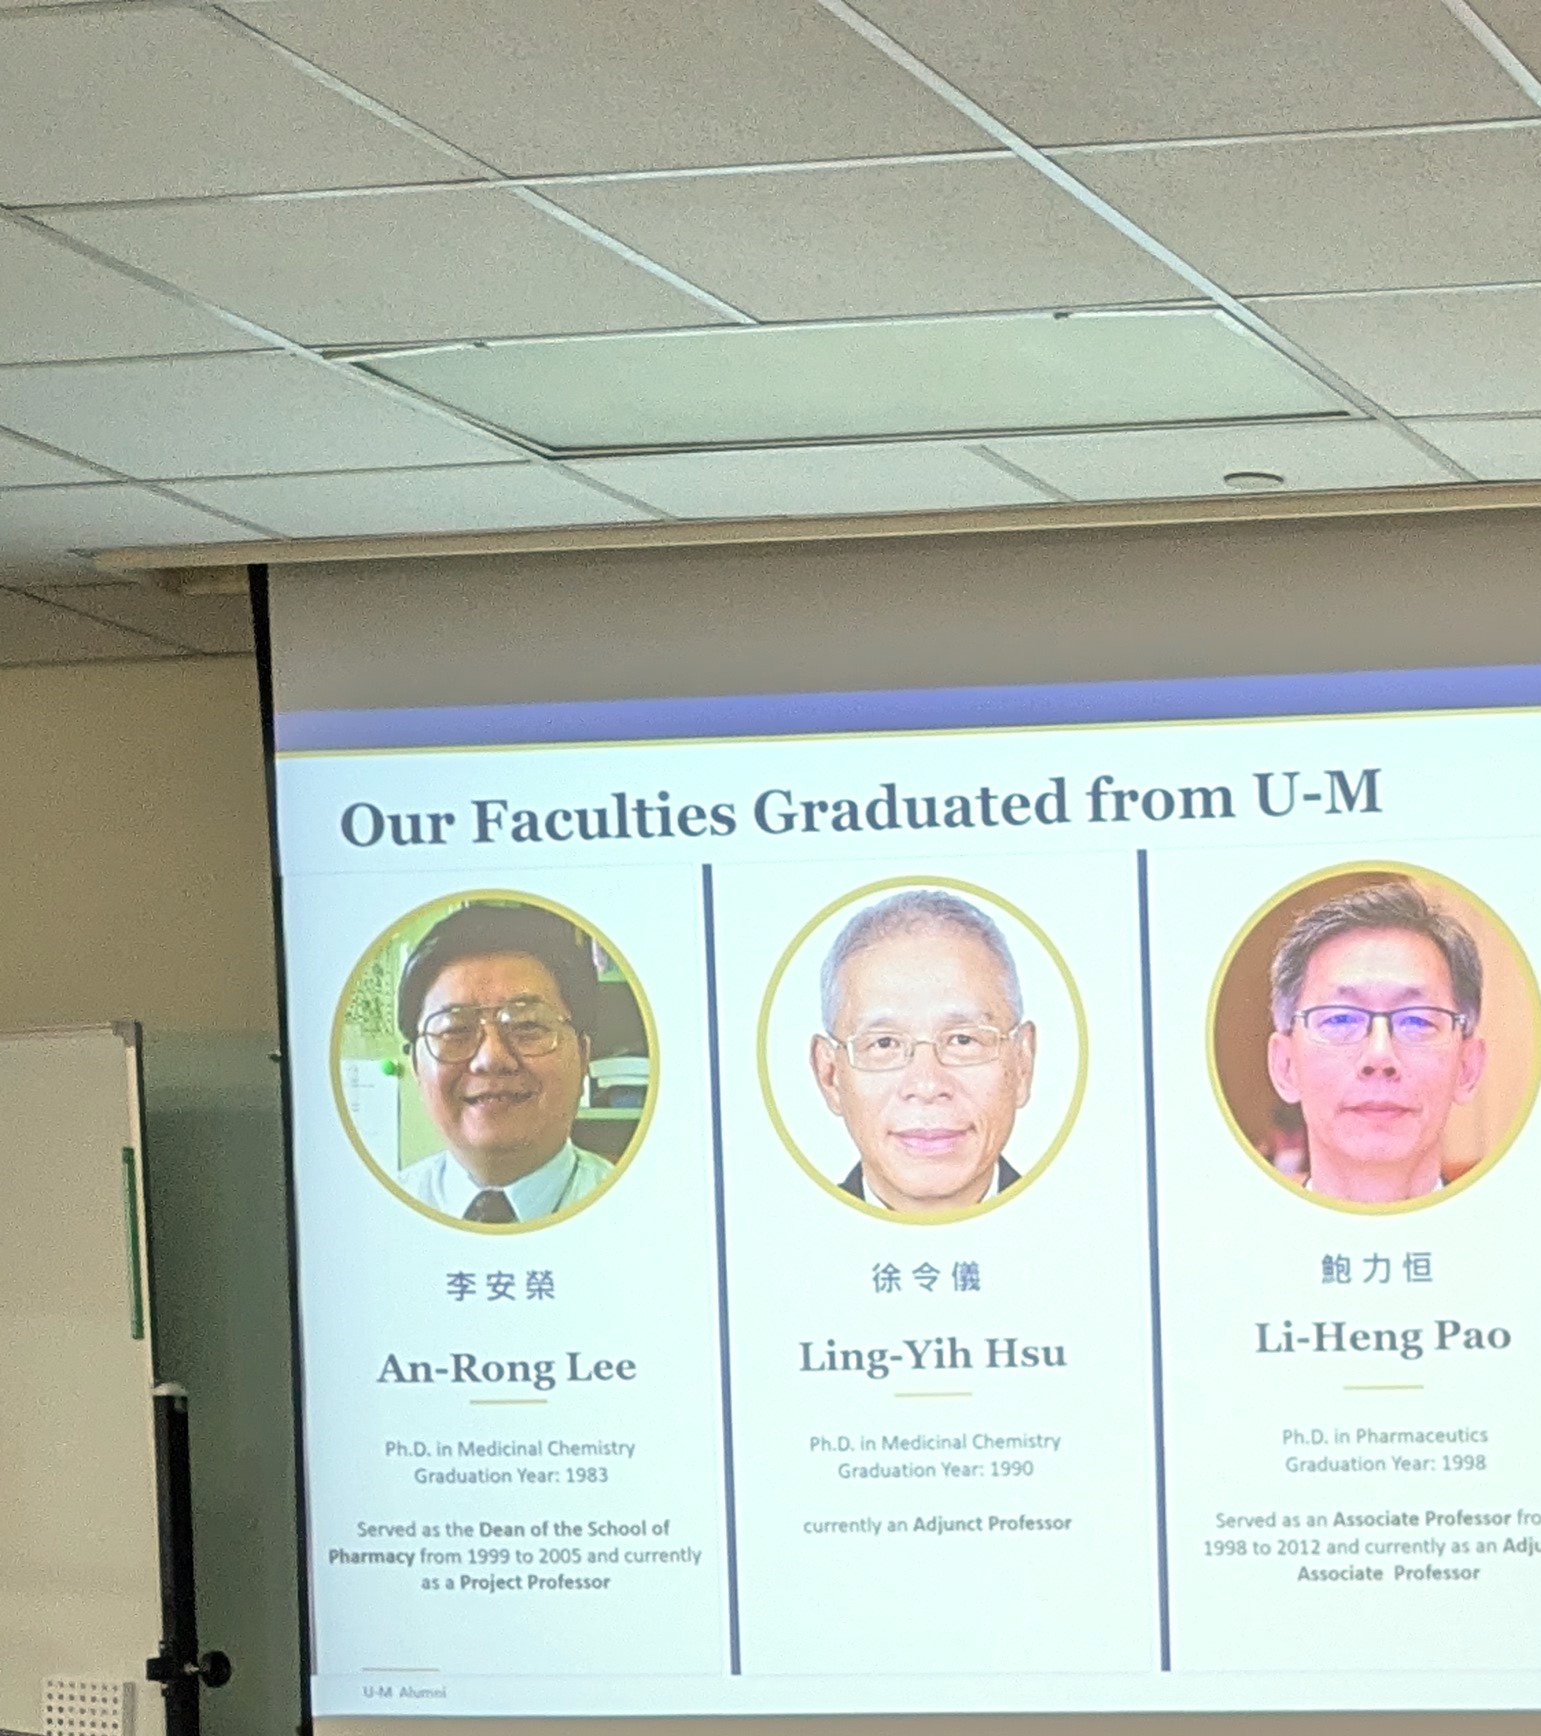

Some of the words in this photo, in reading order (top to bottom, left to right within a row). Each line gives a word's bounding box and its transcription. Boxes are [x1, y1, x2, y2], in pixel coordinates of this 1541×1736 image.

[340, 801, 456, 848] Our
[470, 790, 737, 844] Faculties
[753, 776, 1071, 835] Graduated
[1085, 774, 1237, 823] from
[1252, 767, 1383, 818] U-M
[871, 1260, 981, 1294] 徐令儀
[1321, 1251, 1433, 1285] 鮑力恒
[446, 1269, 555, 1302] 李安榮
[1255, 1319, 1424, 1361] Li-Heng
[1434, 1319, 1512, 1351] Pao
[799, 1336, 973, 1380] Ling-Yih
[985, 1337, 1068, 1368] Hsu
[376, 1352, 556, 1392] An-Rong
[566, 1351, 636, 1382] Lee
[809, 1435, 855, 1452] Ph.D.
[860, 1435, 877, 1451] in
[881, 1433, 967, 1452] Medicinal
[971, 1433, 1062, 1452] Chemistry
[1282, 1428, 1329, 1446] Ph.D.
[1334, 1428, 1351, 1444] in
[1356, 1427, 1489, 1444] Pharmaceutics
[384, 1439, 432, 1458] Ph.D.
[436, 1440, 453, 1457] in
[457, 1440, 543, 1458] Medicinal
[547, 1439, 636, 1459] Chemistry
[837, 1462, 937, 1480] Graduation
[940, 1461, 984, 1478] Year:
[991, 1460, 1035, 1478] 1990
[1285, 1456, 1387, 1473] Graduation
[1391, 1455, 1436, 1472] Year:
[1442, 1454, 1487, 1472] 1998
[413, 1467, 513, 1485] Graduation
[516, 1467, 560, 1484] Year:
[566, 1466, 609, 1484] 1983
[356, 1520, 417, 1538] Served
[421, 1525, 441, 1538] as
[444, 1521, 475, 1538] the
[478, 1521, 526, 1538] Dean
[530, 1520, 549, 1538] of
[553, 1520, 583, 1537] the
[587, 1519, 647, 1537] School
[651, 1518, 670, 1536] of
[803, 1517, 882, 1536] currently
[886, 1520, 908, 1533] an
[912, 1515, 984, 1536] Adjunct
[988, 1514, 1073, 1531] Professor
[1215, 1511, 1277, 1529] Served
[1281, 1515, 1301, 1528] as
[1306, 1515, 1328, 1528] an
[1332, 1509, 1420, 1528] Associate
[1424, 1508, 1512, 1527] Professor
[327, 1547, 416, 1568] Pharmacy
[419, 1547, 462, 1565] from
[468, 1548, 511, 1565] 1999
[515, 1549, 534, 1564] to
[539, 1547, 582, 1564] 2005
[587, 1547, 619, 1564] and
[624, 1546, 702, 1565] currently
[1204, 1539, 1248, 1557] 1998
[1252, 1541, 1272, 1556] to
[1277, 1538, 1321, 1556] 2012
[1326, 1537, 1360, 1555] and
[1364, 1537, 1447, 1558] currently
[1450, 1540, 1471, 1554] as
[1475, 1540, 1498, 1554] an
[1297, 1564, 1384, 1582] Associate
[1394, 1563, 1481, 1581] Professor
[421, 1577, 440, 1591] as
[445, 1577, 455, 1591] a
[459, 1573, 523, 1594] Project
[527, 1573, 611, 1590] Professor
